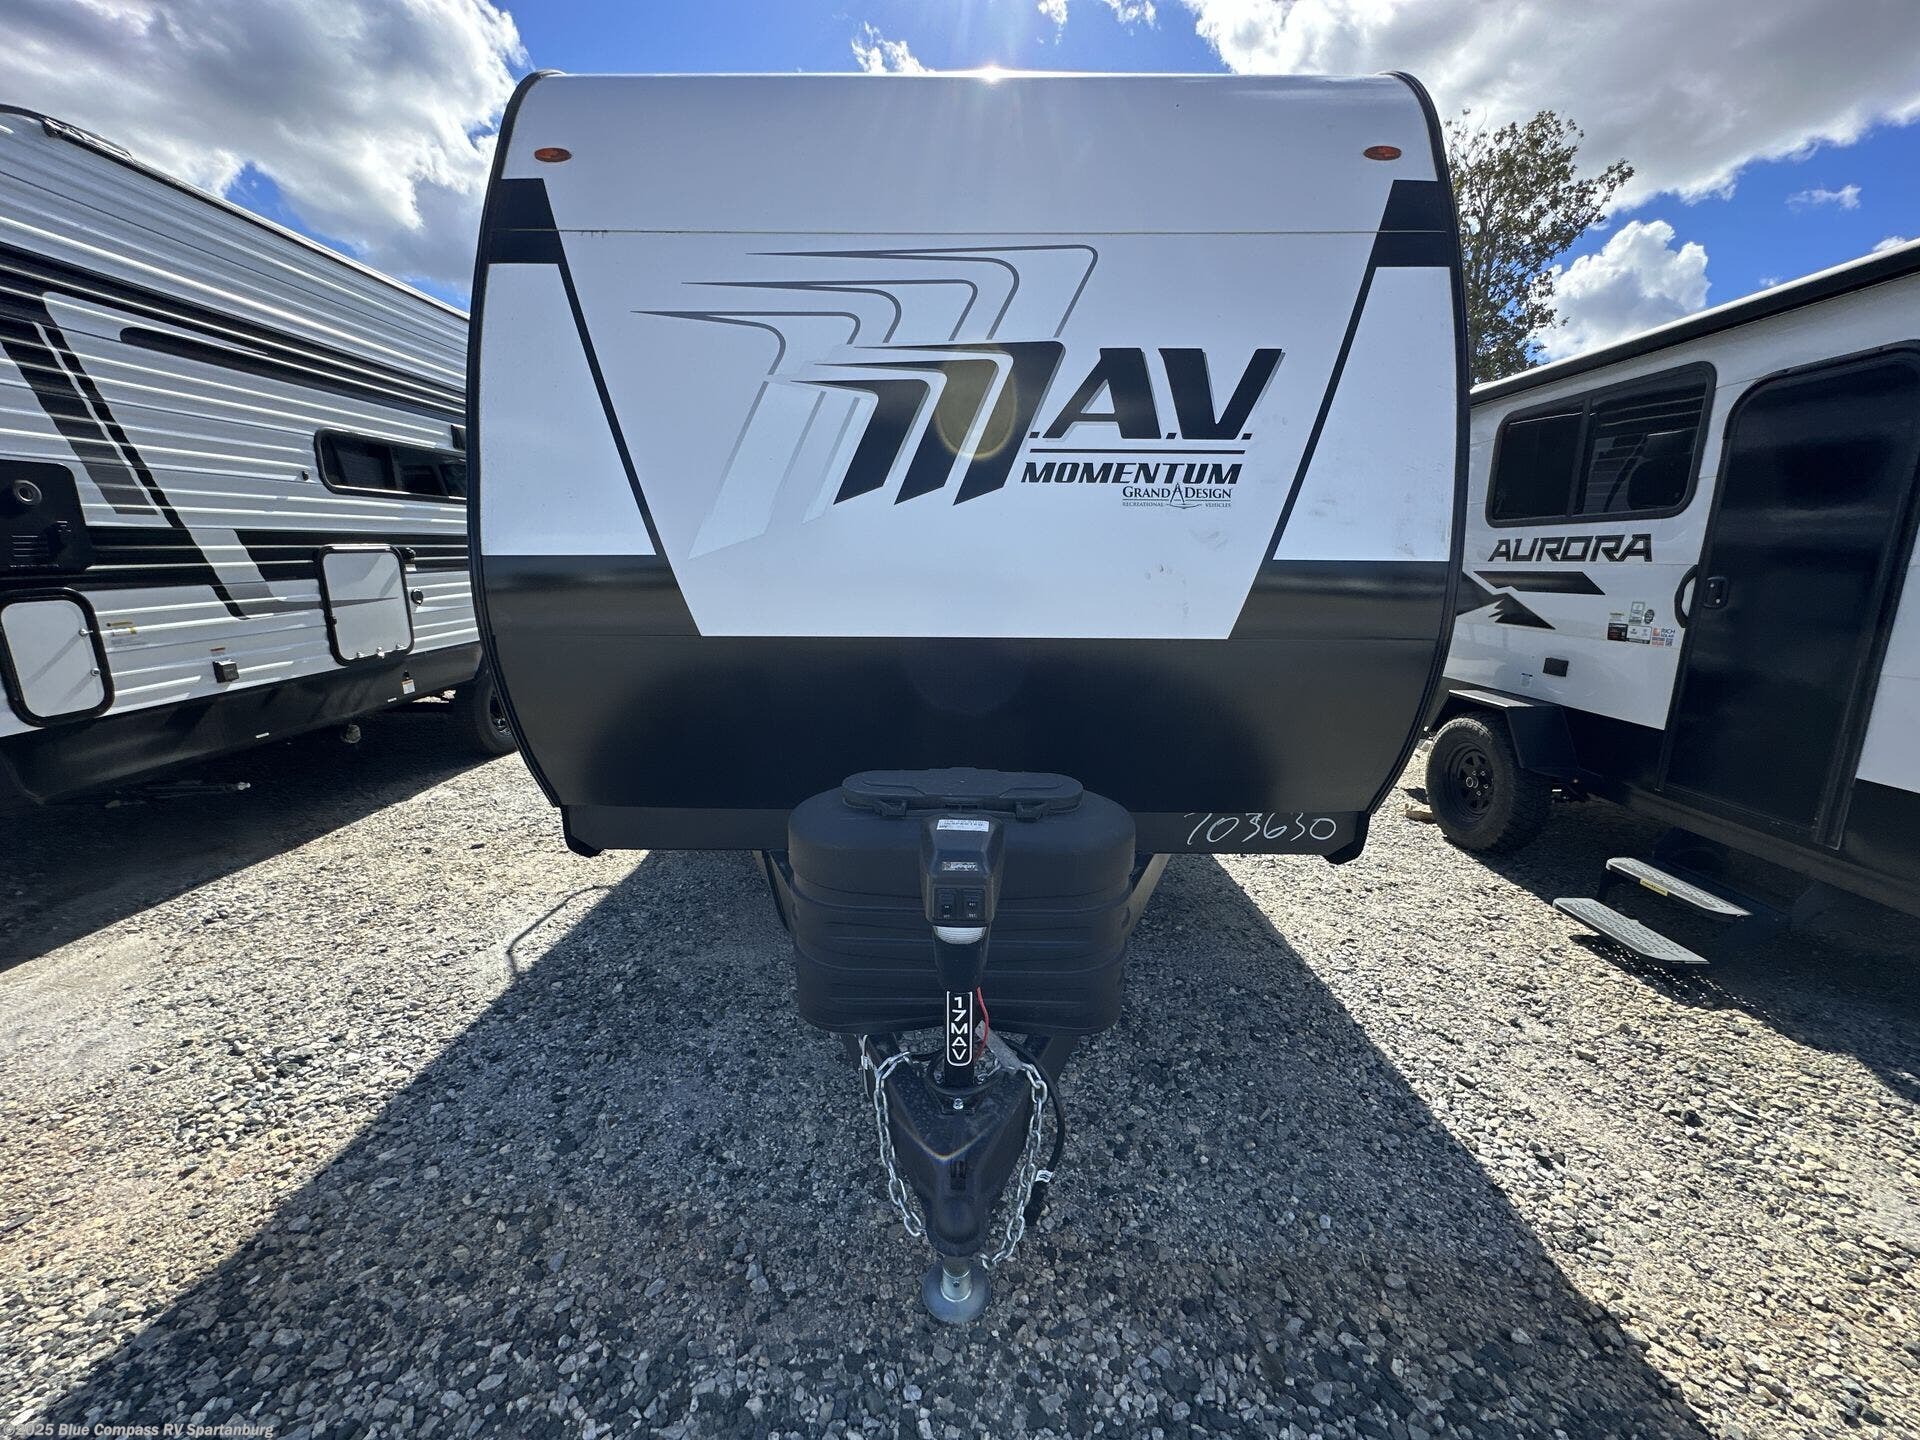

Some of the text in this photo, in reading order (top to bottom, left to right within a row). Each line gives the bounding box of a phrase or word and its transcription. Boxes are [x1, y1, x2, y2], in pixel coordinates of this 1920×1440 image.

[1021, 462, 1243, 484] MOMENTUM
[1122, 485, 1232, 499] GRAND DESIGN
[1487, 533, 1653, 562] AURORA
[950, 996, 968, 1060] 17MAV
